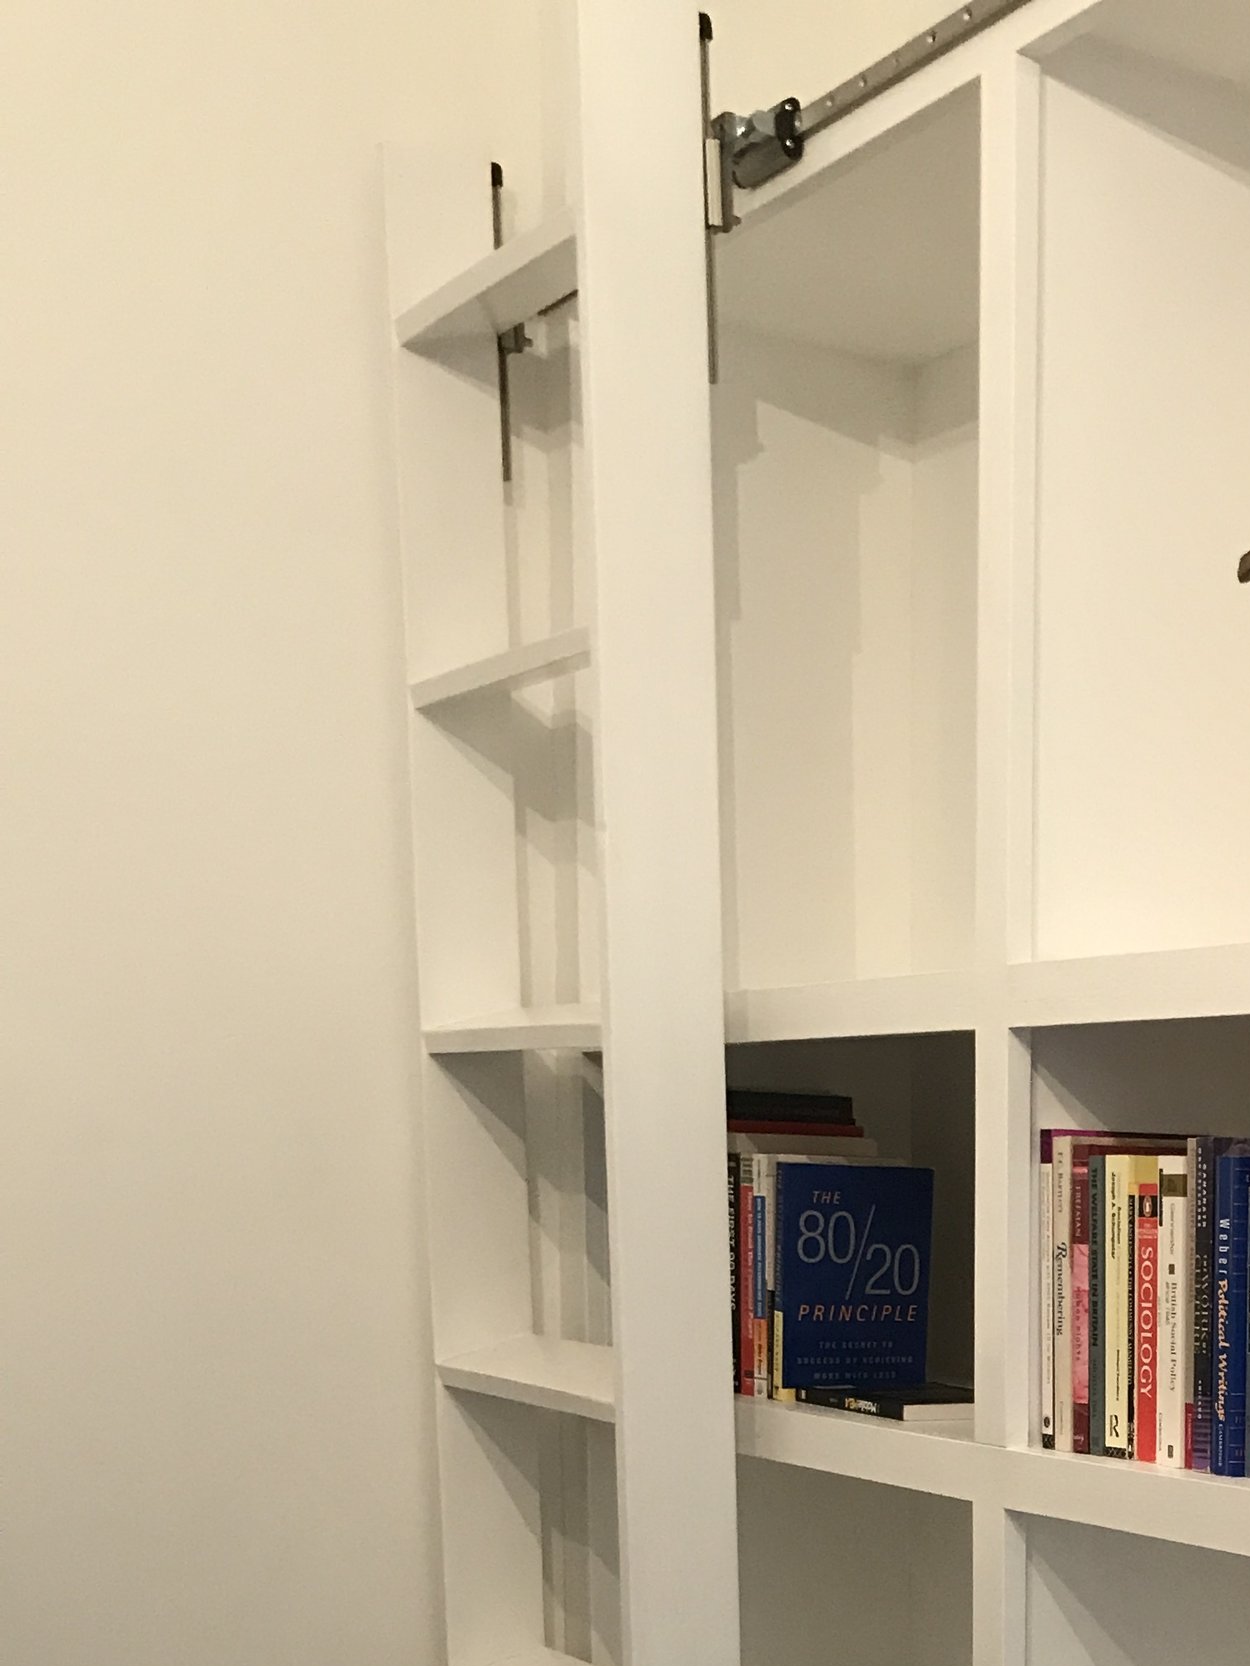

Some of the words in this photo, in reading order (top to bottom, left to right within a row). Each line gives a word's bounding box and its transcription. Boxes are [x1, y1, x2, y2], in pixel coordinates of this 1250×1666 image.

[812, 1190, 842, 1204] THE
[1091, 1168, 1099, 1190] THE
[1091, 1193, 1099, 1246] WELFARE
[797, 1204, 920, 1300] 80/20
[1091, 1249, 1099, 1280] STATE
[1219, 1218, 1231, 1275] Weber
[798, 1304, 919, 1322] PRINCIPLE
[1056, 1242, 1068, 1336] Remembering
[1091, 1283, 1099, 1297] IN
[1215, 1279, 1230, 1349] Political
[1091, 1300, 1099, 1347] BRITAIN
[1139, 1246, 1154, 1399] SOCIOLOGY
[1169, 1358, 1177, 1392] Policy
[1214, 1352, 1230, 1422] Writings
